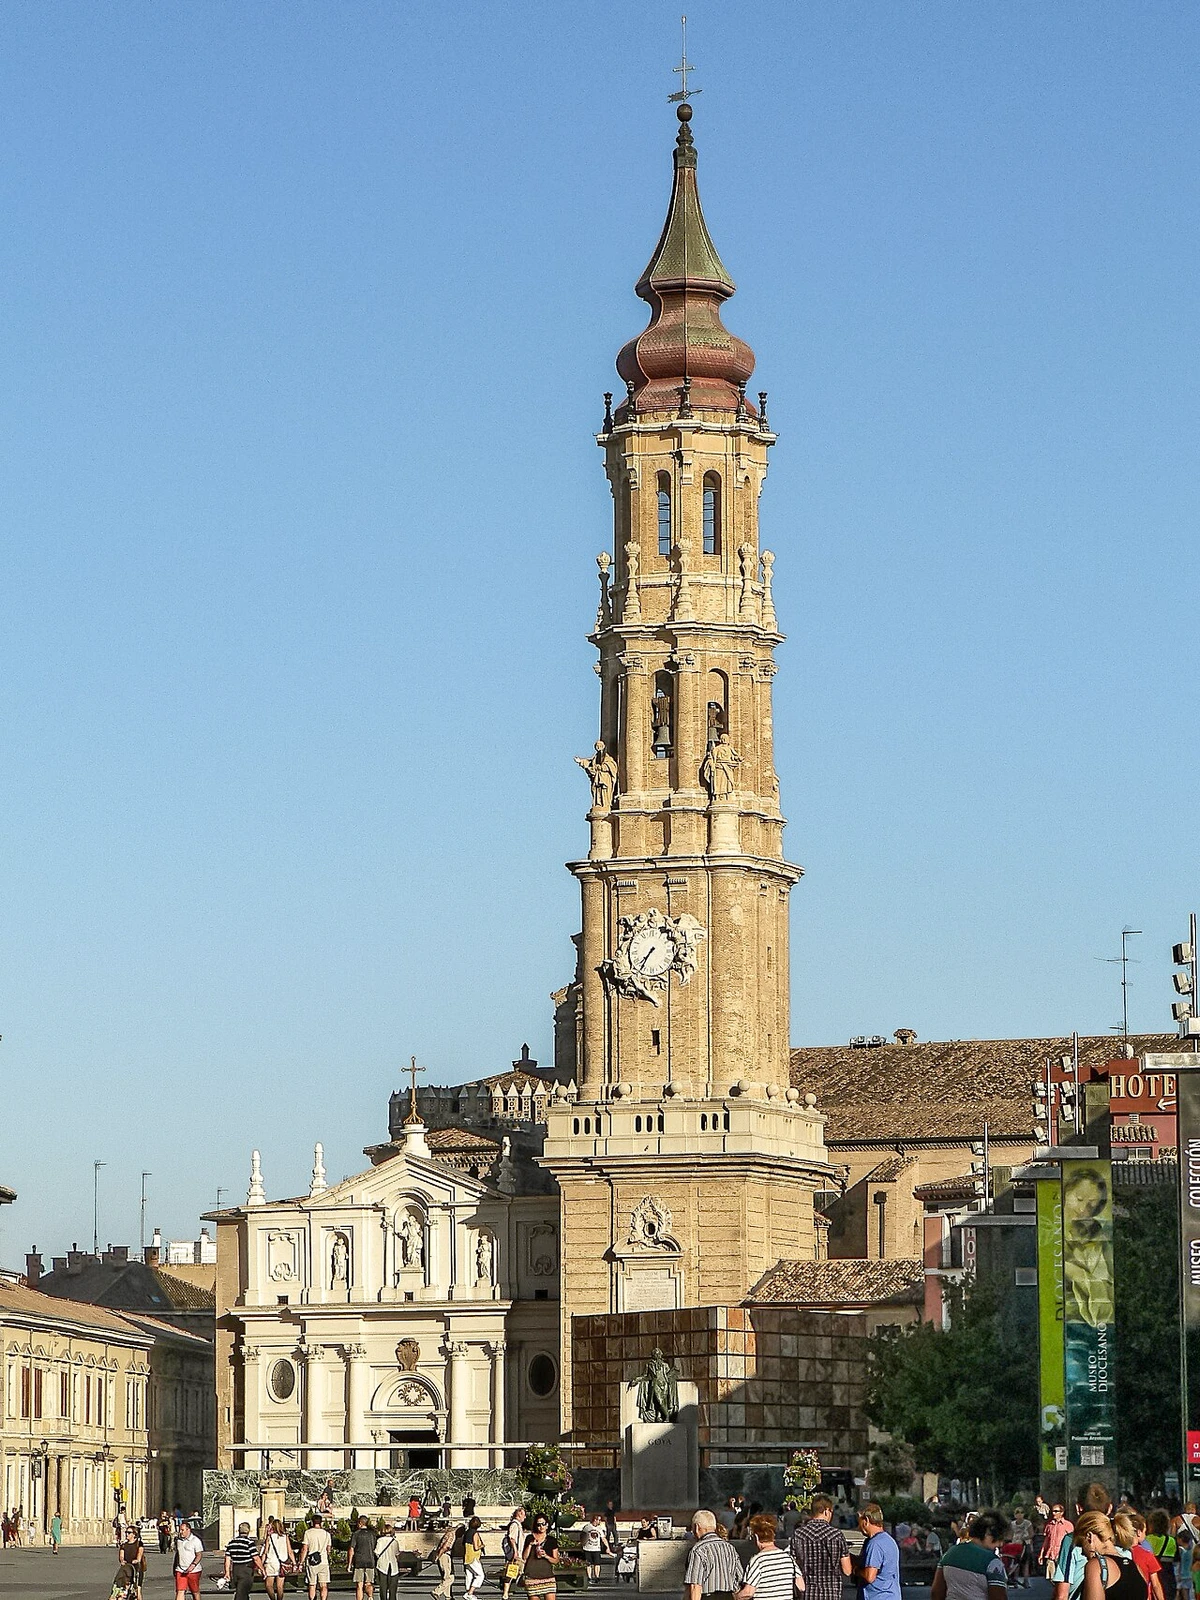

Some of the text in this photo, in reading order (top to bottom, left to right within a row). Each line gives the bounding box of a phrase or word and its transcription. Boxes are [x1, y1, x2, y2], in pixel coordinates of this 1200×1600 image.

[1088, 1355, 1098, 1393] MUSEO
[1097, 1321, 1108, 1393] DIOCESANO
[648, 1438, 672, 1446] GOYA
